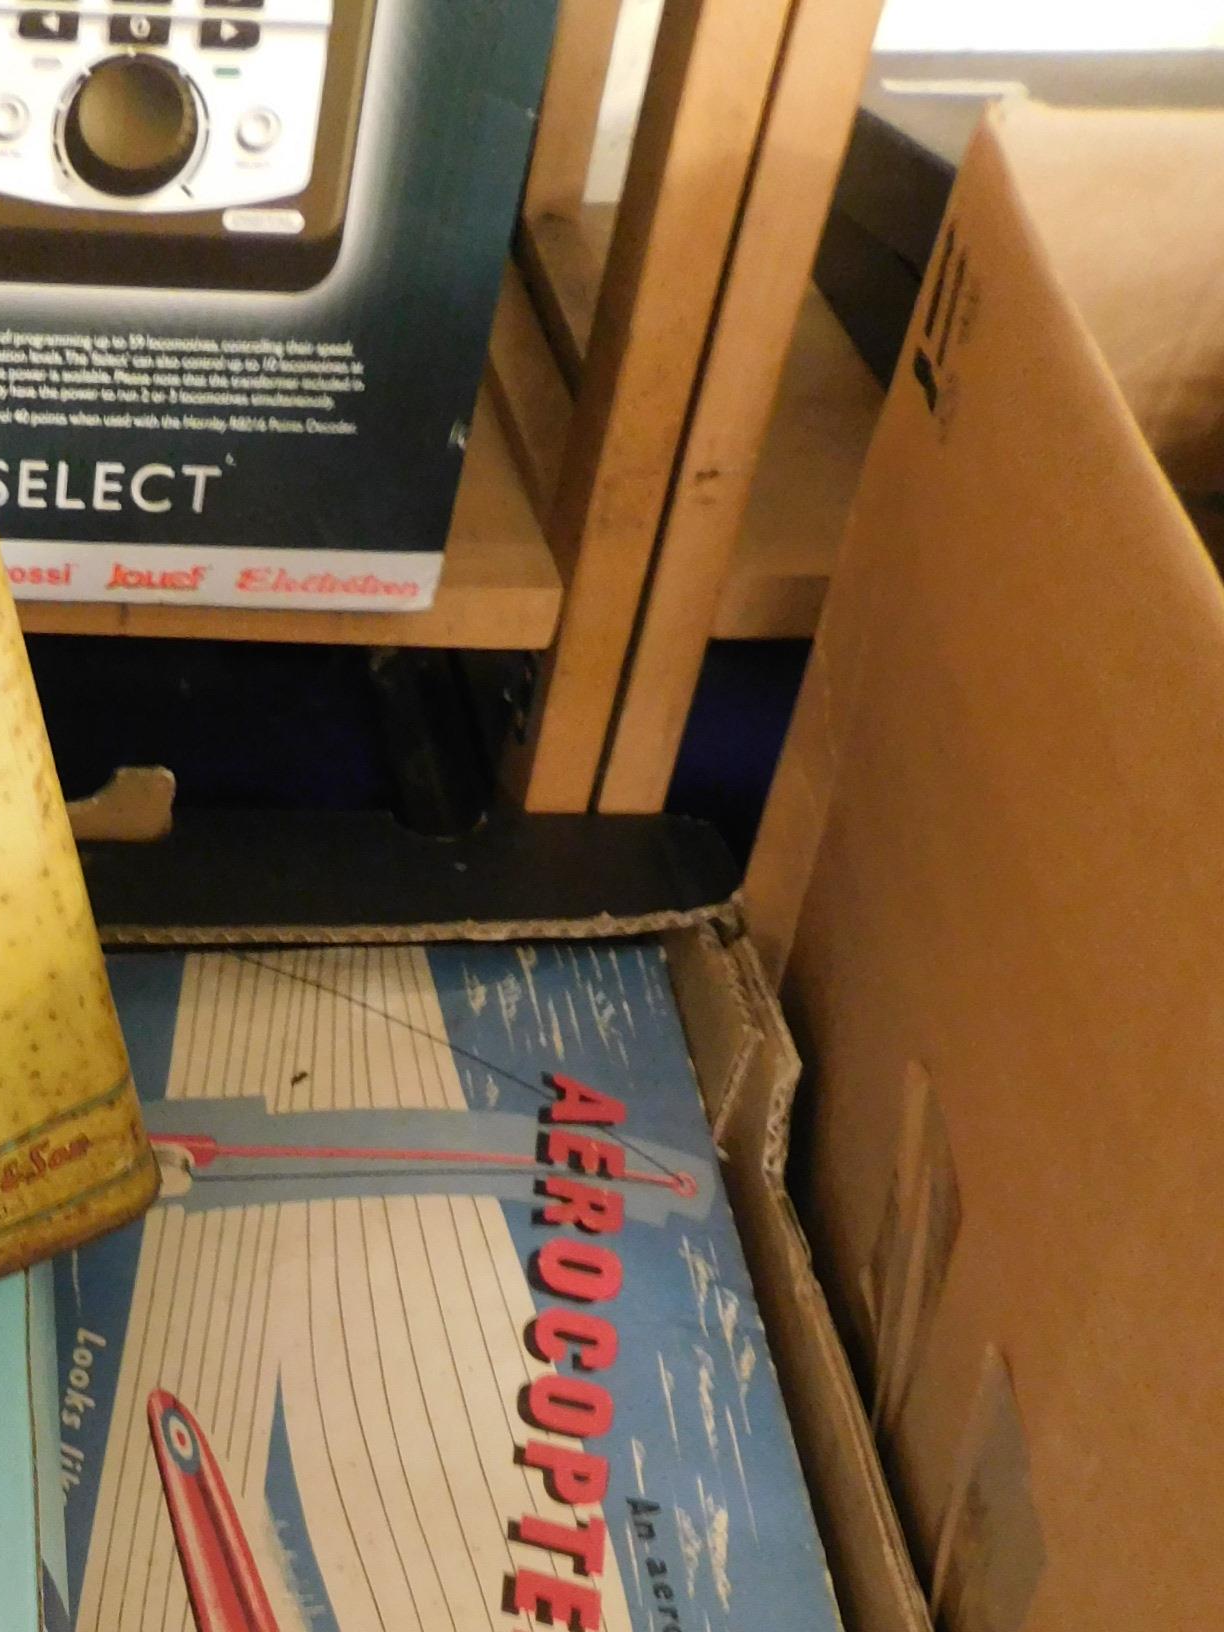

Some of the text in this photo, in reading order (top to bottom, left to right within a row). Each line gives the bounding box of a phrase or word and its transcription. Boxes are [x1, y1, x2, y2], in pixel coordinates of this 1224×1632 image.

[13, 332, 92, 351] programming
[94, 334, 111, 350] up
[112, 335, 126, 348] to
[286, 338, 313, 355] their
[66, 349, 88, 366] The
[132, 355, 154, 369] can
[155, 353, 180, 369] also
[182, 354, 225, 371] control
[228, 358, 244, 374] up
[245, 356, 260, 372] to
[183, 414, 226, 434] Hornby
[106, 564, 207, 590] Jouef
[61, 1328, 108, 1430] Looks
[626, 1497, 662, 1543] An
